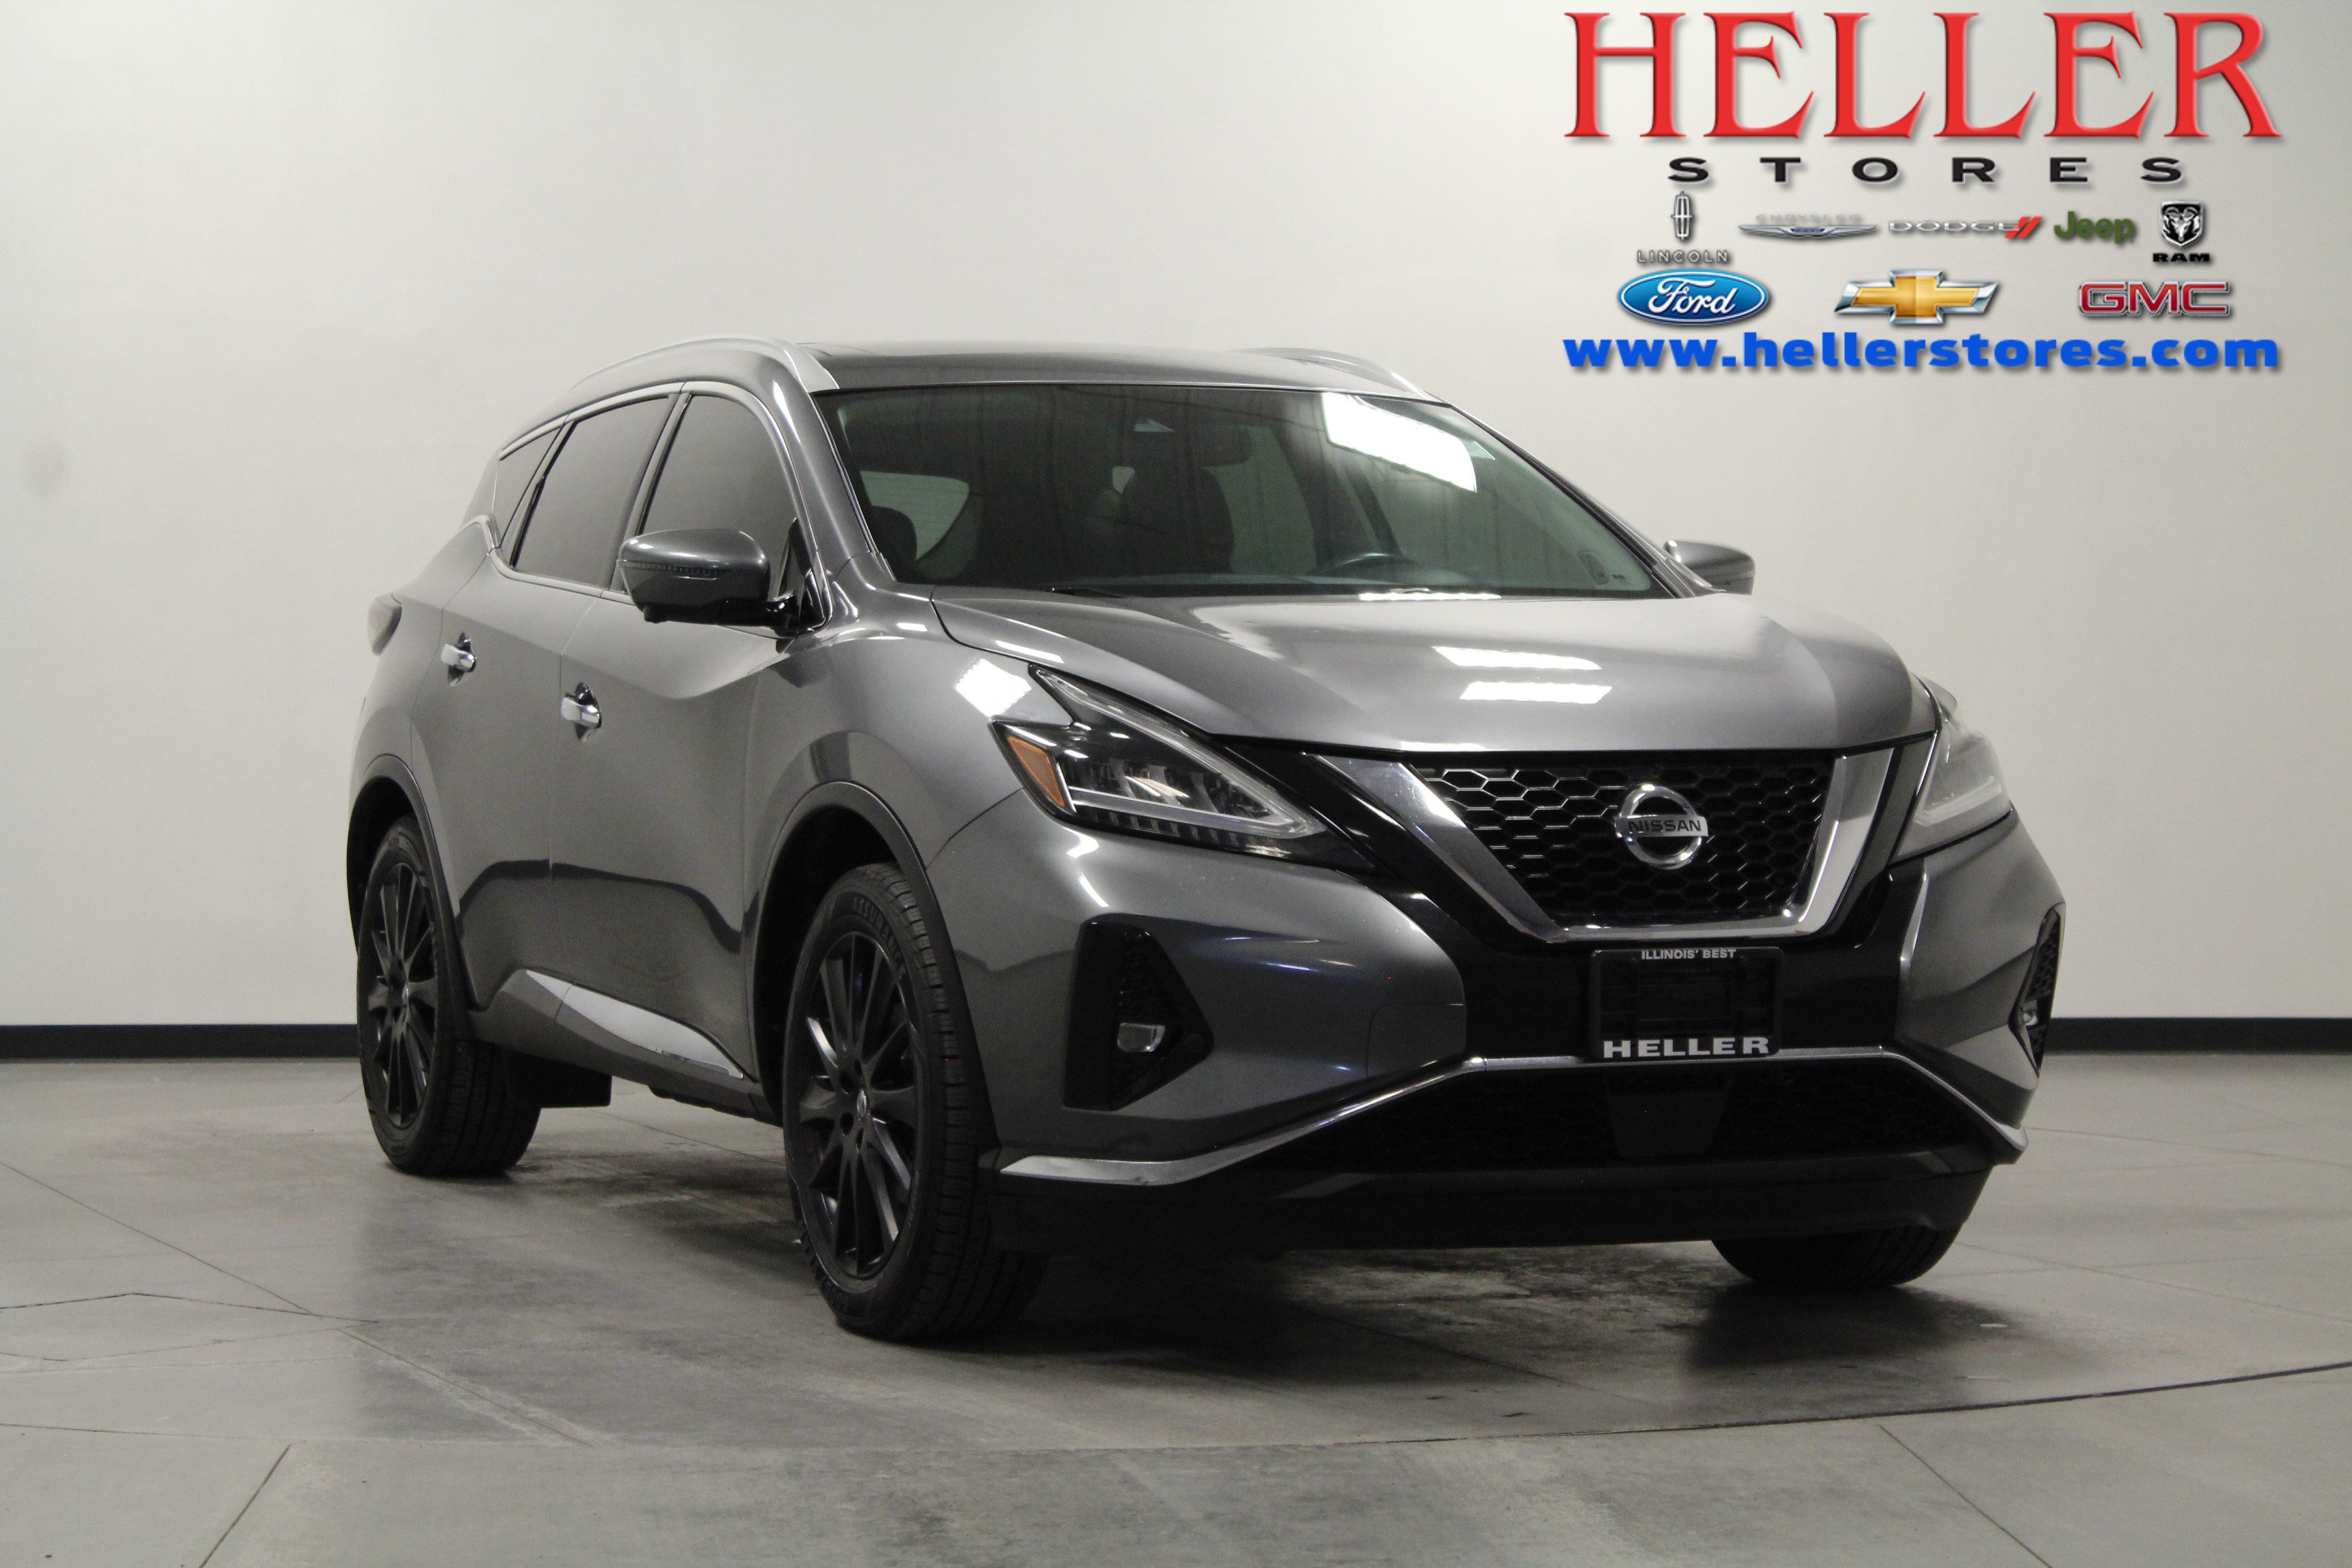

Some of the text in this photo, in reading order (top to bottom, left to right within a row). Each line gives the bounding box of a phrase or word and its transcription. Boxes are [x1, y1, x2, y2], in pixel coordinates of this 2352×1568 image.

[1627, 819, 1702, 832] NISSAN
[1702, 949, 1737, 959] BEST
[1603, 1036, 1769, 1058] HELLER
